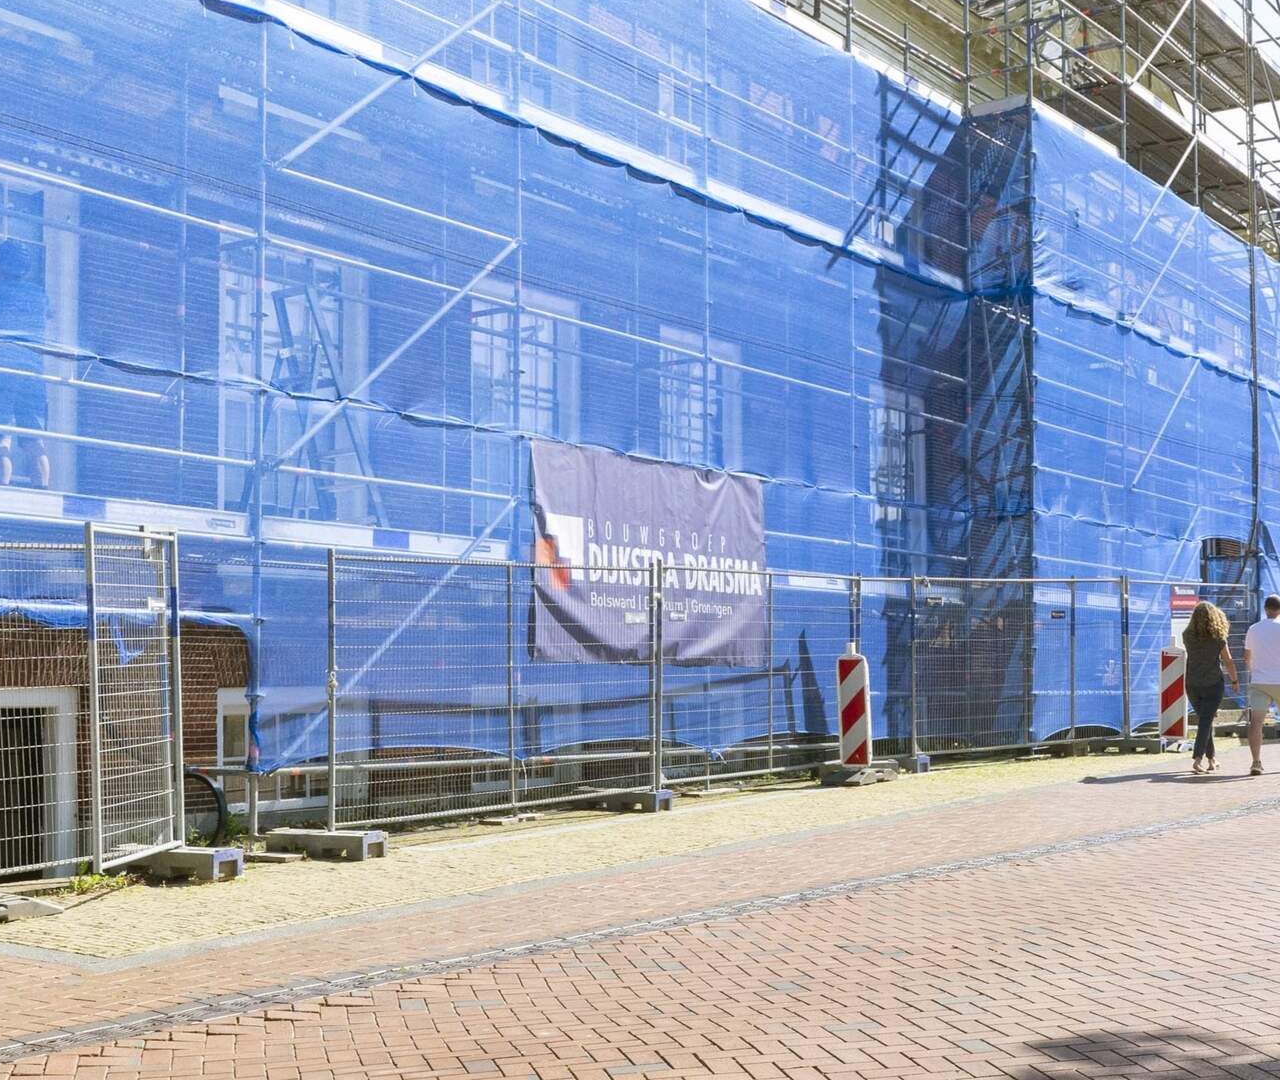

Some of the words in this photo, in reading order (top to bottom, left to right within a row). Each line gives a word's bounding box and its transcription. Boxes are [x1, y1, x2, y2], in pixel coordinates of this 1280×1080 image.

[587, 518, 726, 553] BOUWGROEP
[588, 543, 680, 590] DIJKSTRA
[684, 553, 762, 596] DRAISMA
[590, 591, 636, 609] Bolsward
[691, 601, 733, 620] Groningen
